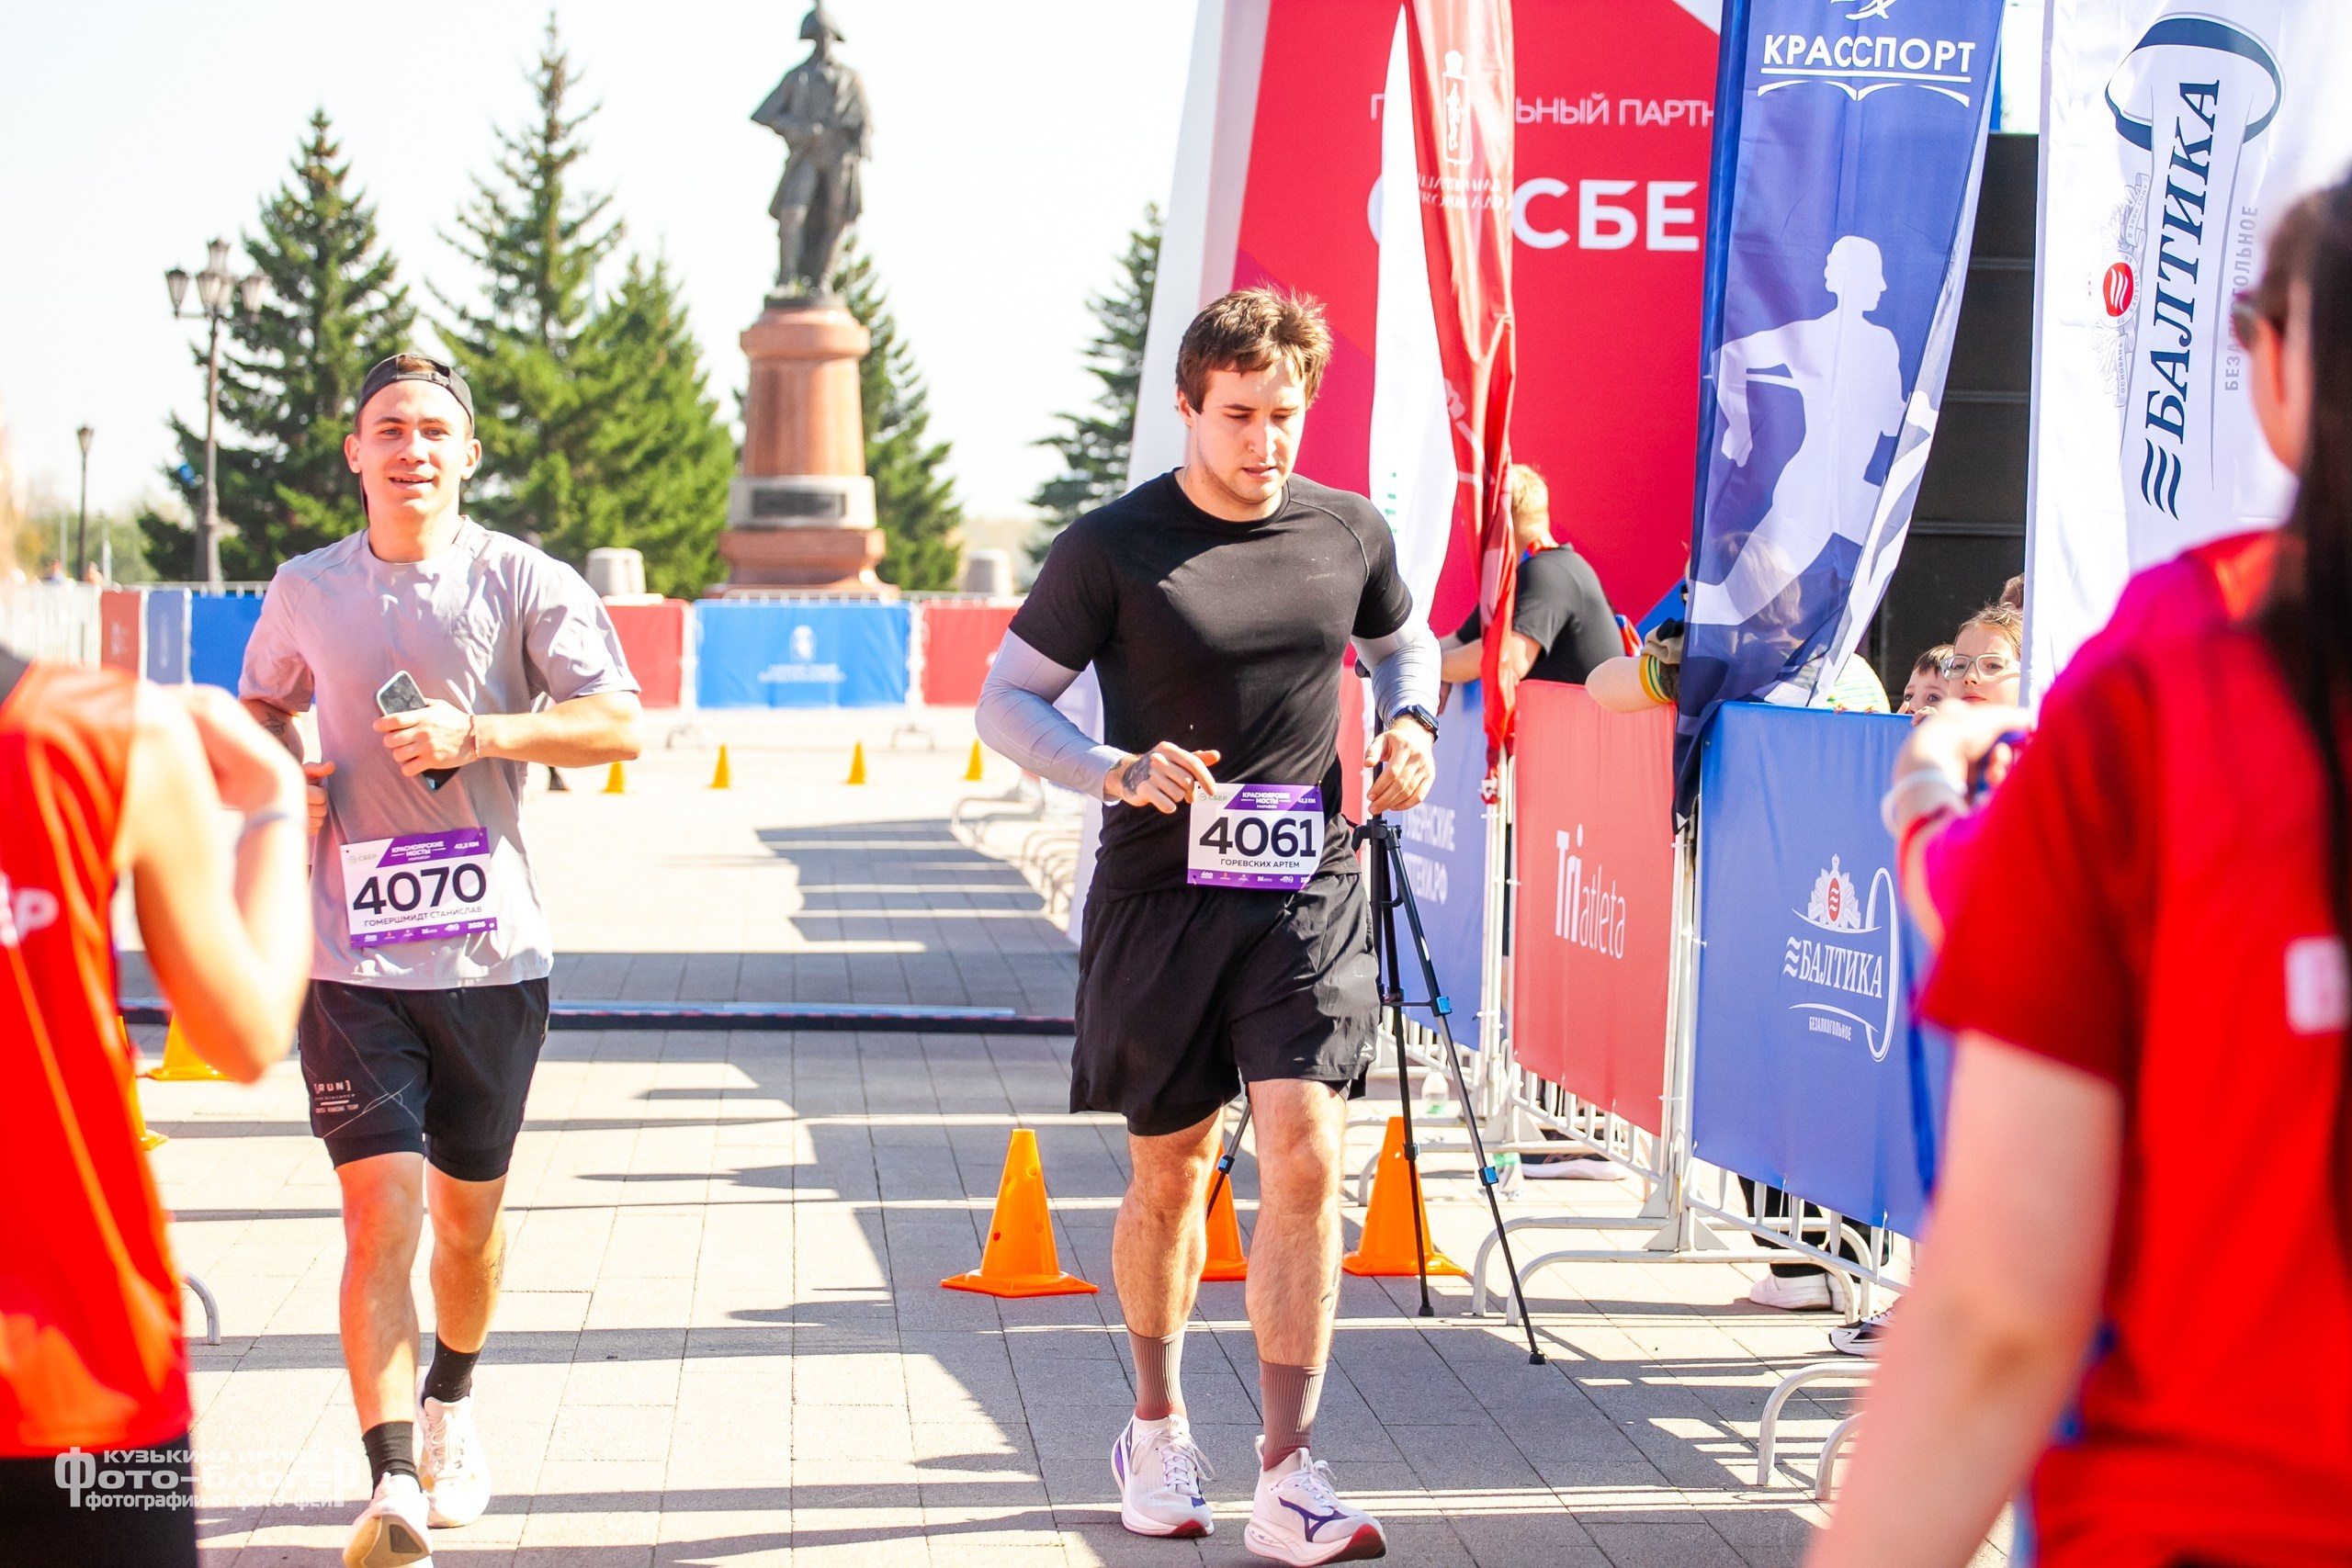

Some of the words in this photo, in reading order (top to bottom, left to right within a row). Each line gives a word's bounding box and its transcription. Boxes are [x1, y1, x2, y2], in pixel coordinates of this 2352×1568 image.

[1763, 34, 1976, 73] КРАССПОРТ
[1619, 98, 1714, 127] ПАРТН
[1510, 176, 1700, 251] СБЕ
[2146, 80, 2220, 446] БАЛТИКА
[1199, 817, 1317, 858] 4061
[1220, 858, 1272, 868] ГОРЕВСКИХ
[353, 863, 487, 915] 4070
[364, 912, 428, 928] ГОМЕРШМИДТ
[429, 906, 483, 919] СТАНИСЛАВ
[1798, 939, 1883, 998] БАЛТИКА
[1808, 1016, 1852, 1042] БЕЗАЛКОГОЛЬНОЕ
